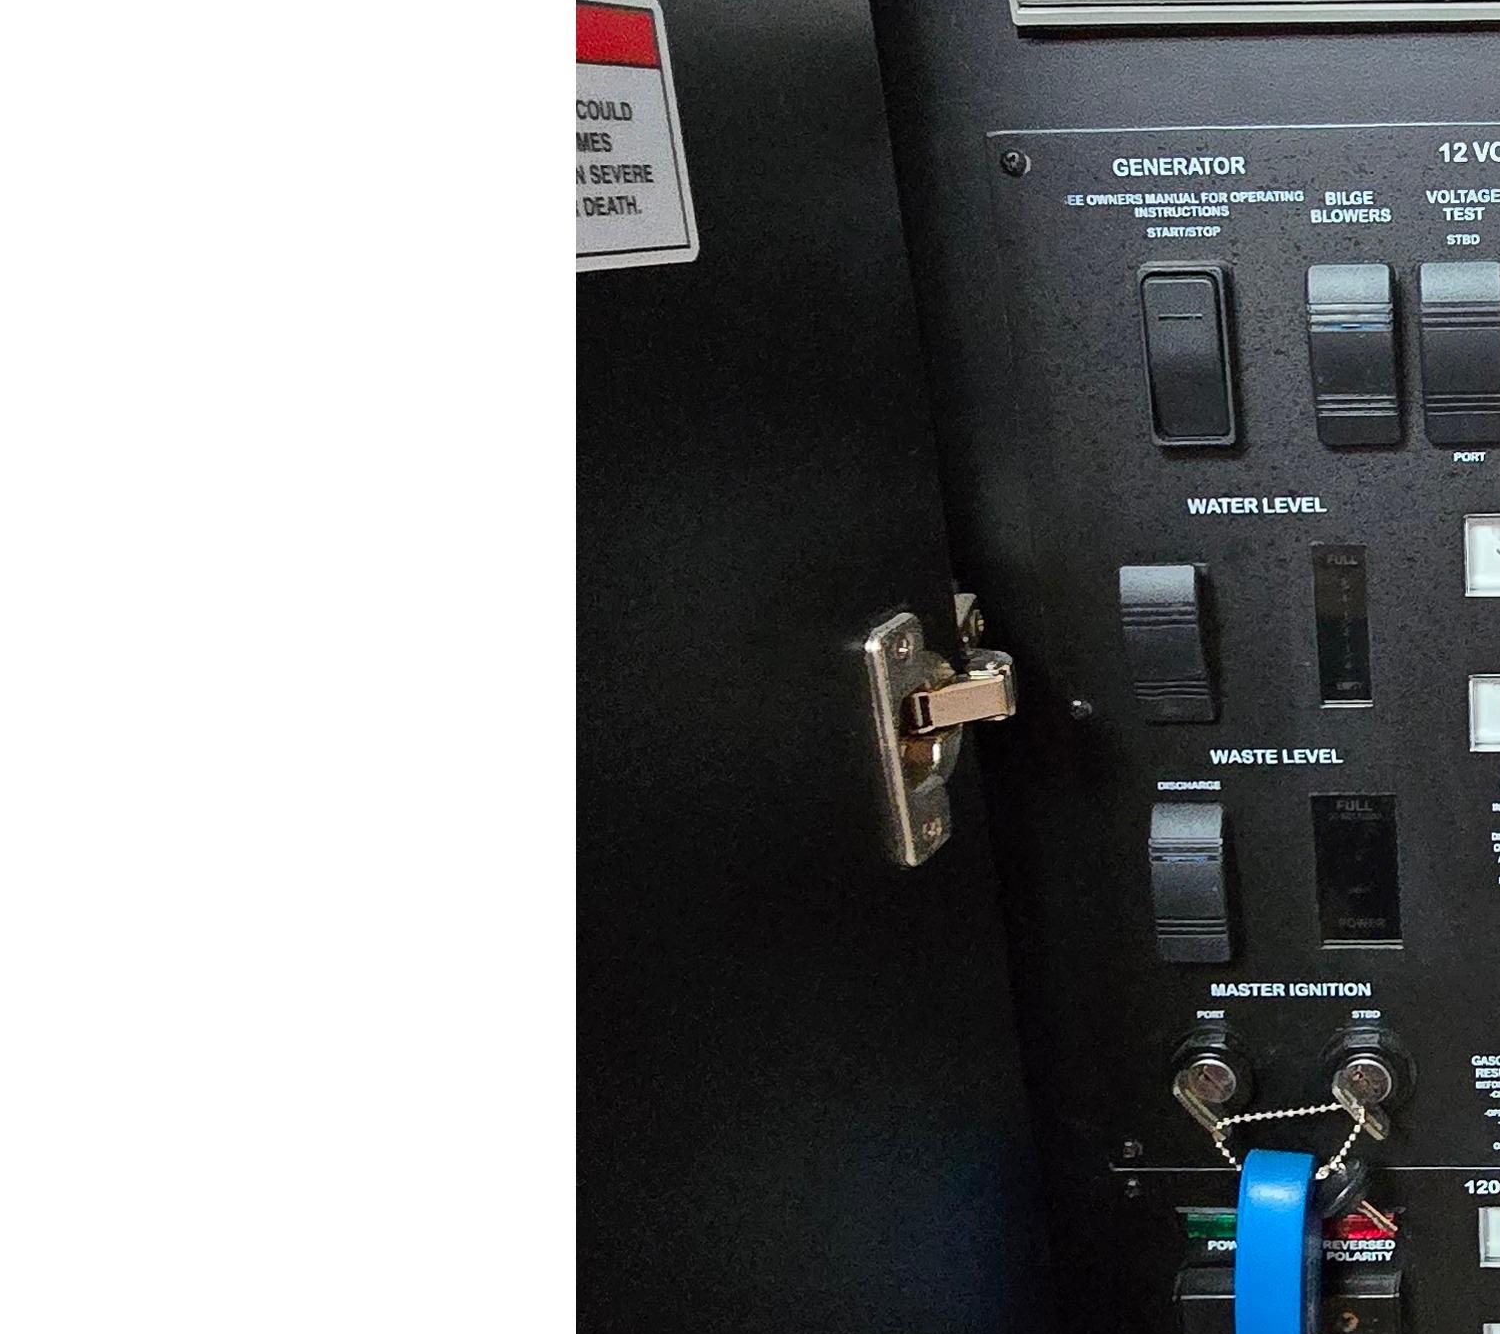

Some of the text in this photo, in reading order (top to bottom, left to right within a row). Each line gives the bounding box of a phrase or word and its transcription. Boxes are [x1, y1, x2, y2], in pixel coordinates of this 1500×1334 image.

[576, 100, 632, 121] COULD
[1439, 142, 1468, 163] 12
[1112, 157, 1245, 176] GENERATOR
[590, 165, 654, 183] SEVERE
[1065, 191, 1304, 205] EE OWNERS MANUAL FOR OPERATING
[1325, 191, 1373, 205] BILGE
[1426, 189, 1500, 203] VOLTAGE
[584, 196, 642, 216] DEATH.
[1134, 206, 1229, 218] INSTRUCTIONS
[1310, 209, 1391, 224] BLOWERS
[1443, 207, 1485, 221] TEST
[1147, 226, 1221, 238] START/STOP
[1446, 234, 1480, 245] STBD
[1454, 452, 1486, 461] PORT
[1188, 496, 1327, 515] WATER LEVEL
[1210, 748, 1343, 765] WASTE LEVEL
[1157, 780, 1222, 791] DISCHARGE
[1211, 983, 1371, 997] MASTER IGNITION
[1197, 1010, 1225, 1019] PORT
[1352, 1010, 1381, 1019] STBD
[1464, 1179, 1500, 1195] 120
[1208, 1240, 1236, 1251] POW
[1323, 1240, 1396, 1250] REVERSED
[1326, 1251, 1393, 1261] POLARITY
